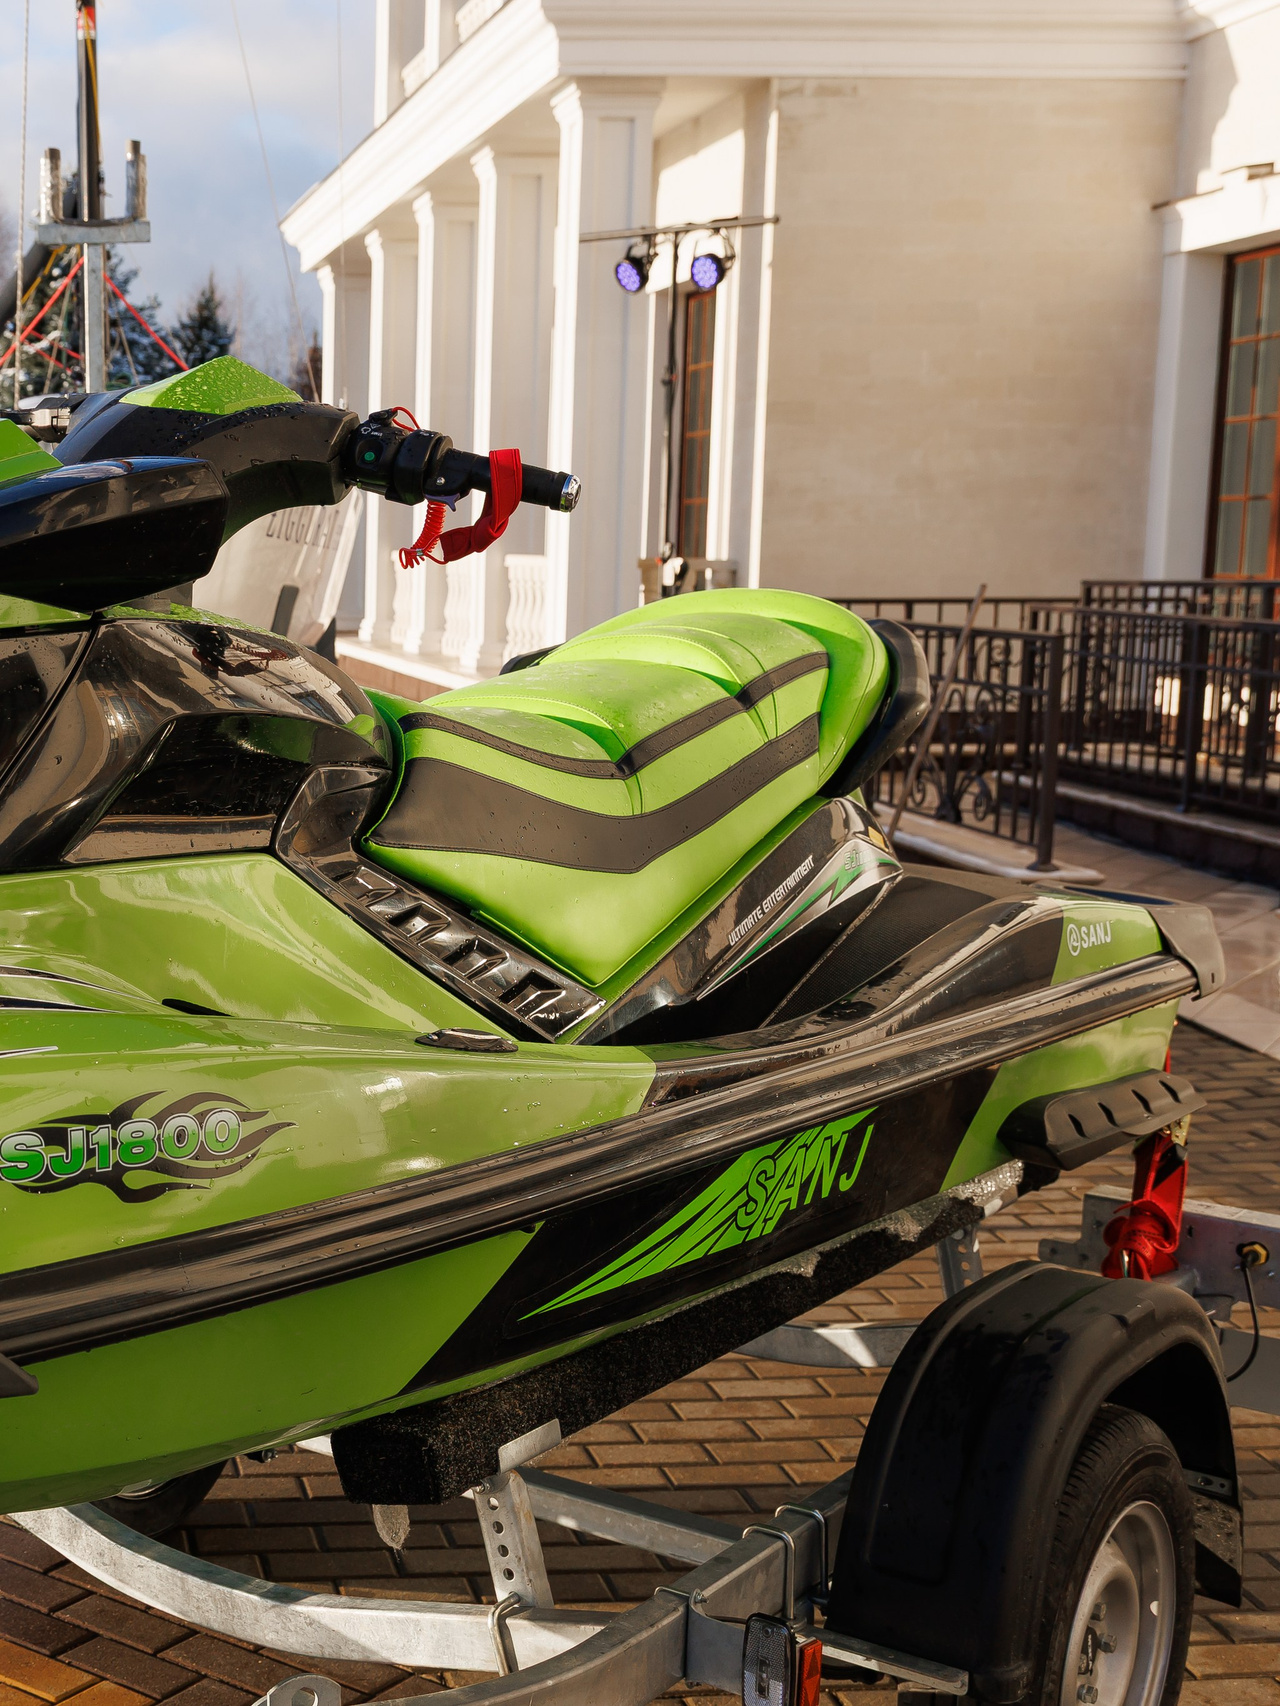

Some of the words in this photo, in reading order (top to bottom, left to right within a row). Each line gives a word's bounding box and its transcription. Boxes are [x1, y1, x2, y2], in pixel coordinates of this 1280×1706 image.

[728, 906, 763, 946] ULTIMATE
[762, 855, 814, 913] ENTERTAINMENT
[1081, 920, 1111, 949] SANJ
[736, 1124, 874, 1228] SANJ
